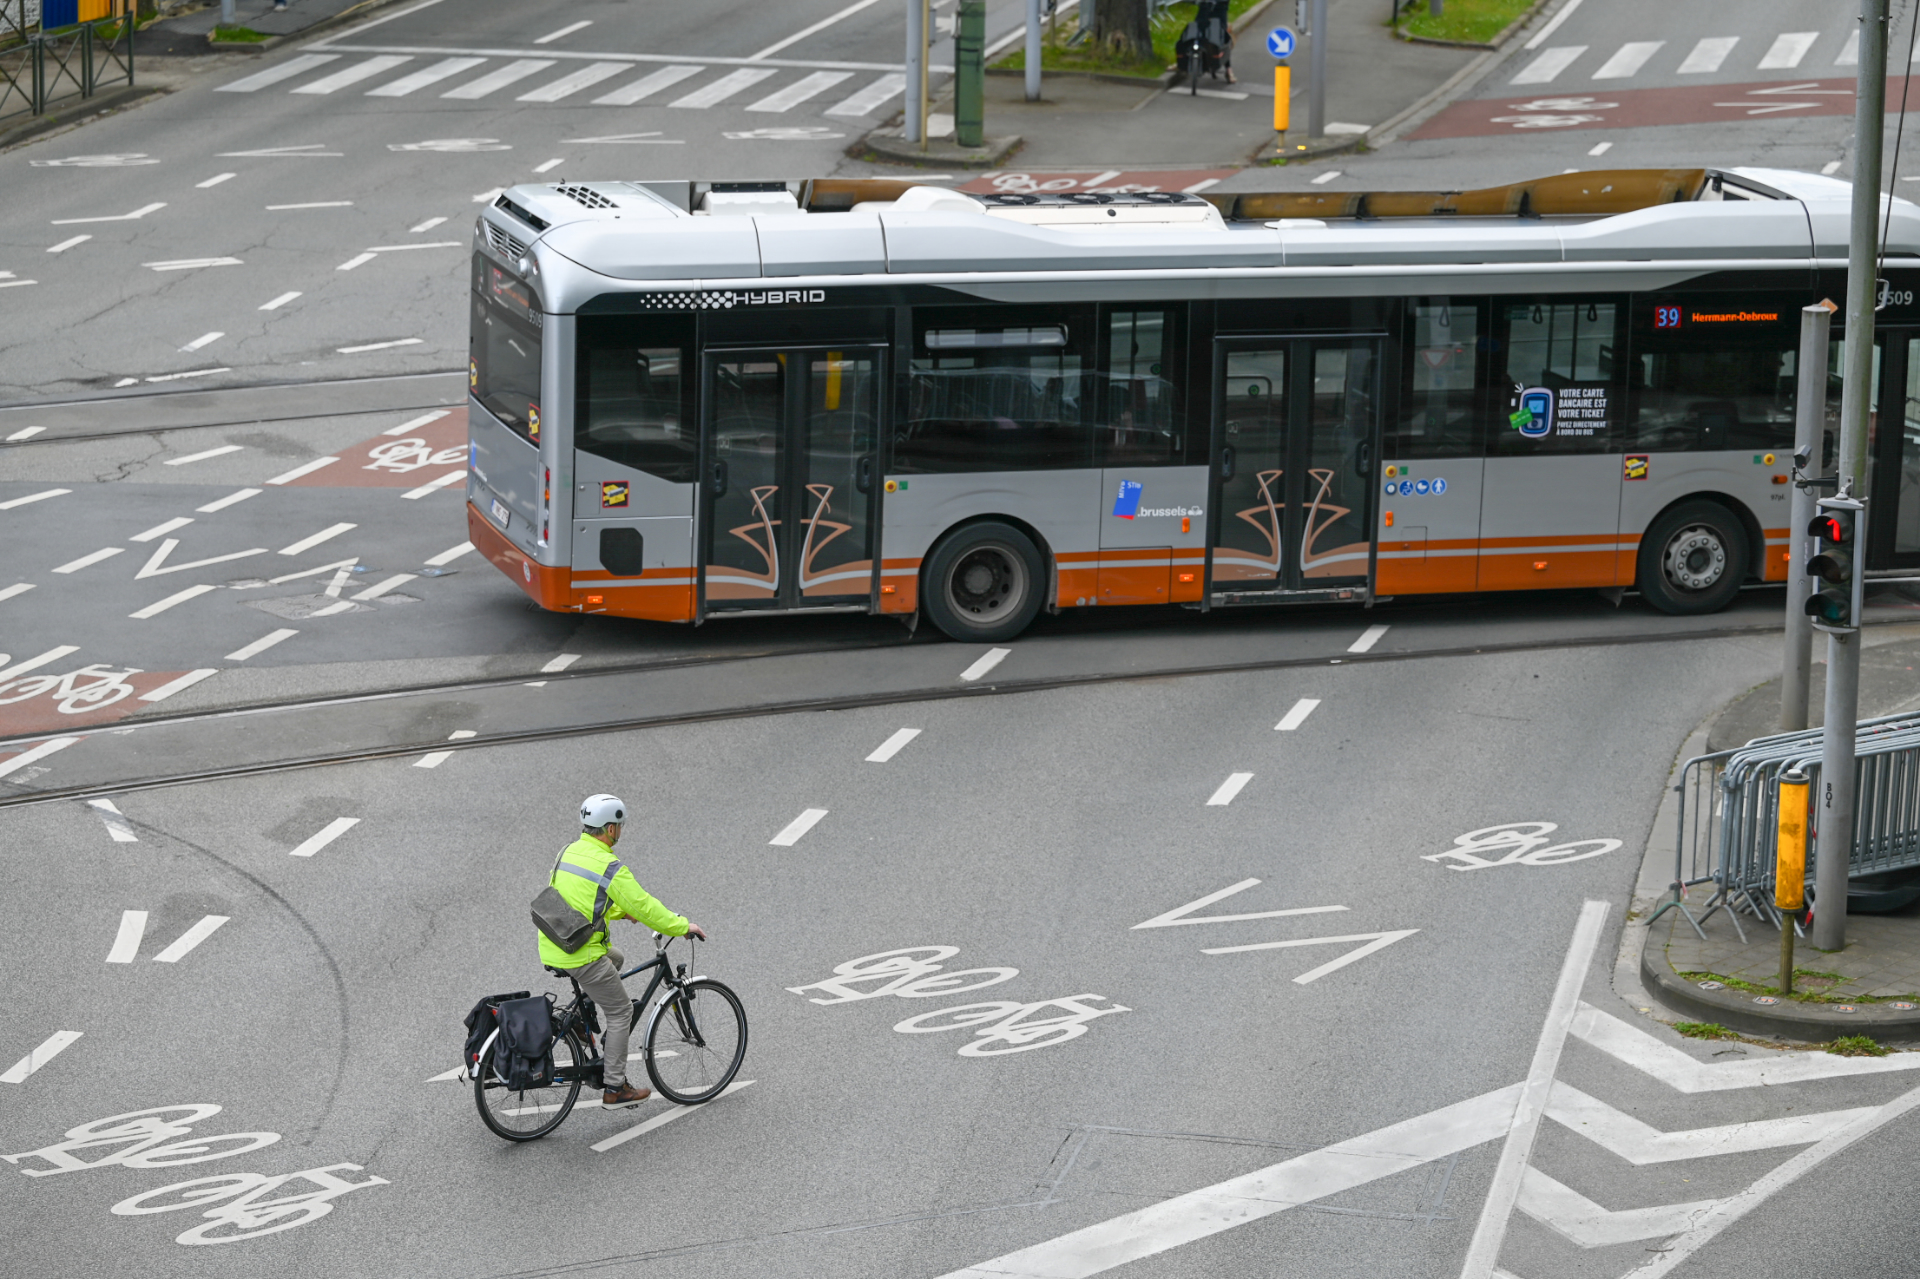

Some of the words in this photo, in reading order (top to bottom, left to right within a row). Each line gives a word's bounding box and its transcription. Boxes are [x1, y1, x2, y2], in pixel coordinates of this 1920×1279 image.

[733, 290, 825, 305] HYBRID
[1658, 308, 1679, 327] 39
[1692, 311, 1778, 322] Herrmann-Debroux
[1559, 389, 1581, 397] VOTRE
[1582, 388, 1605, 398] CARTE
[1558, 399, 1593, 408] BANCAIRE
[1594, 399, 1607, 408] EST
[1558, 409, 1580, 418] VOTRE
[1581, 409, 1605, 418] TICKET
